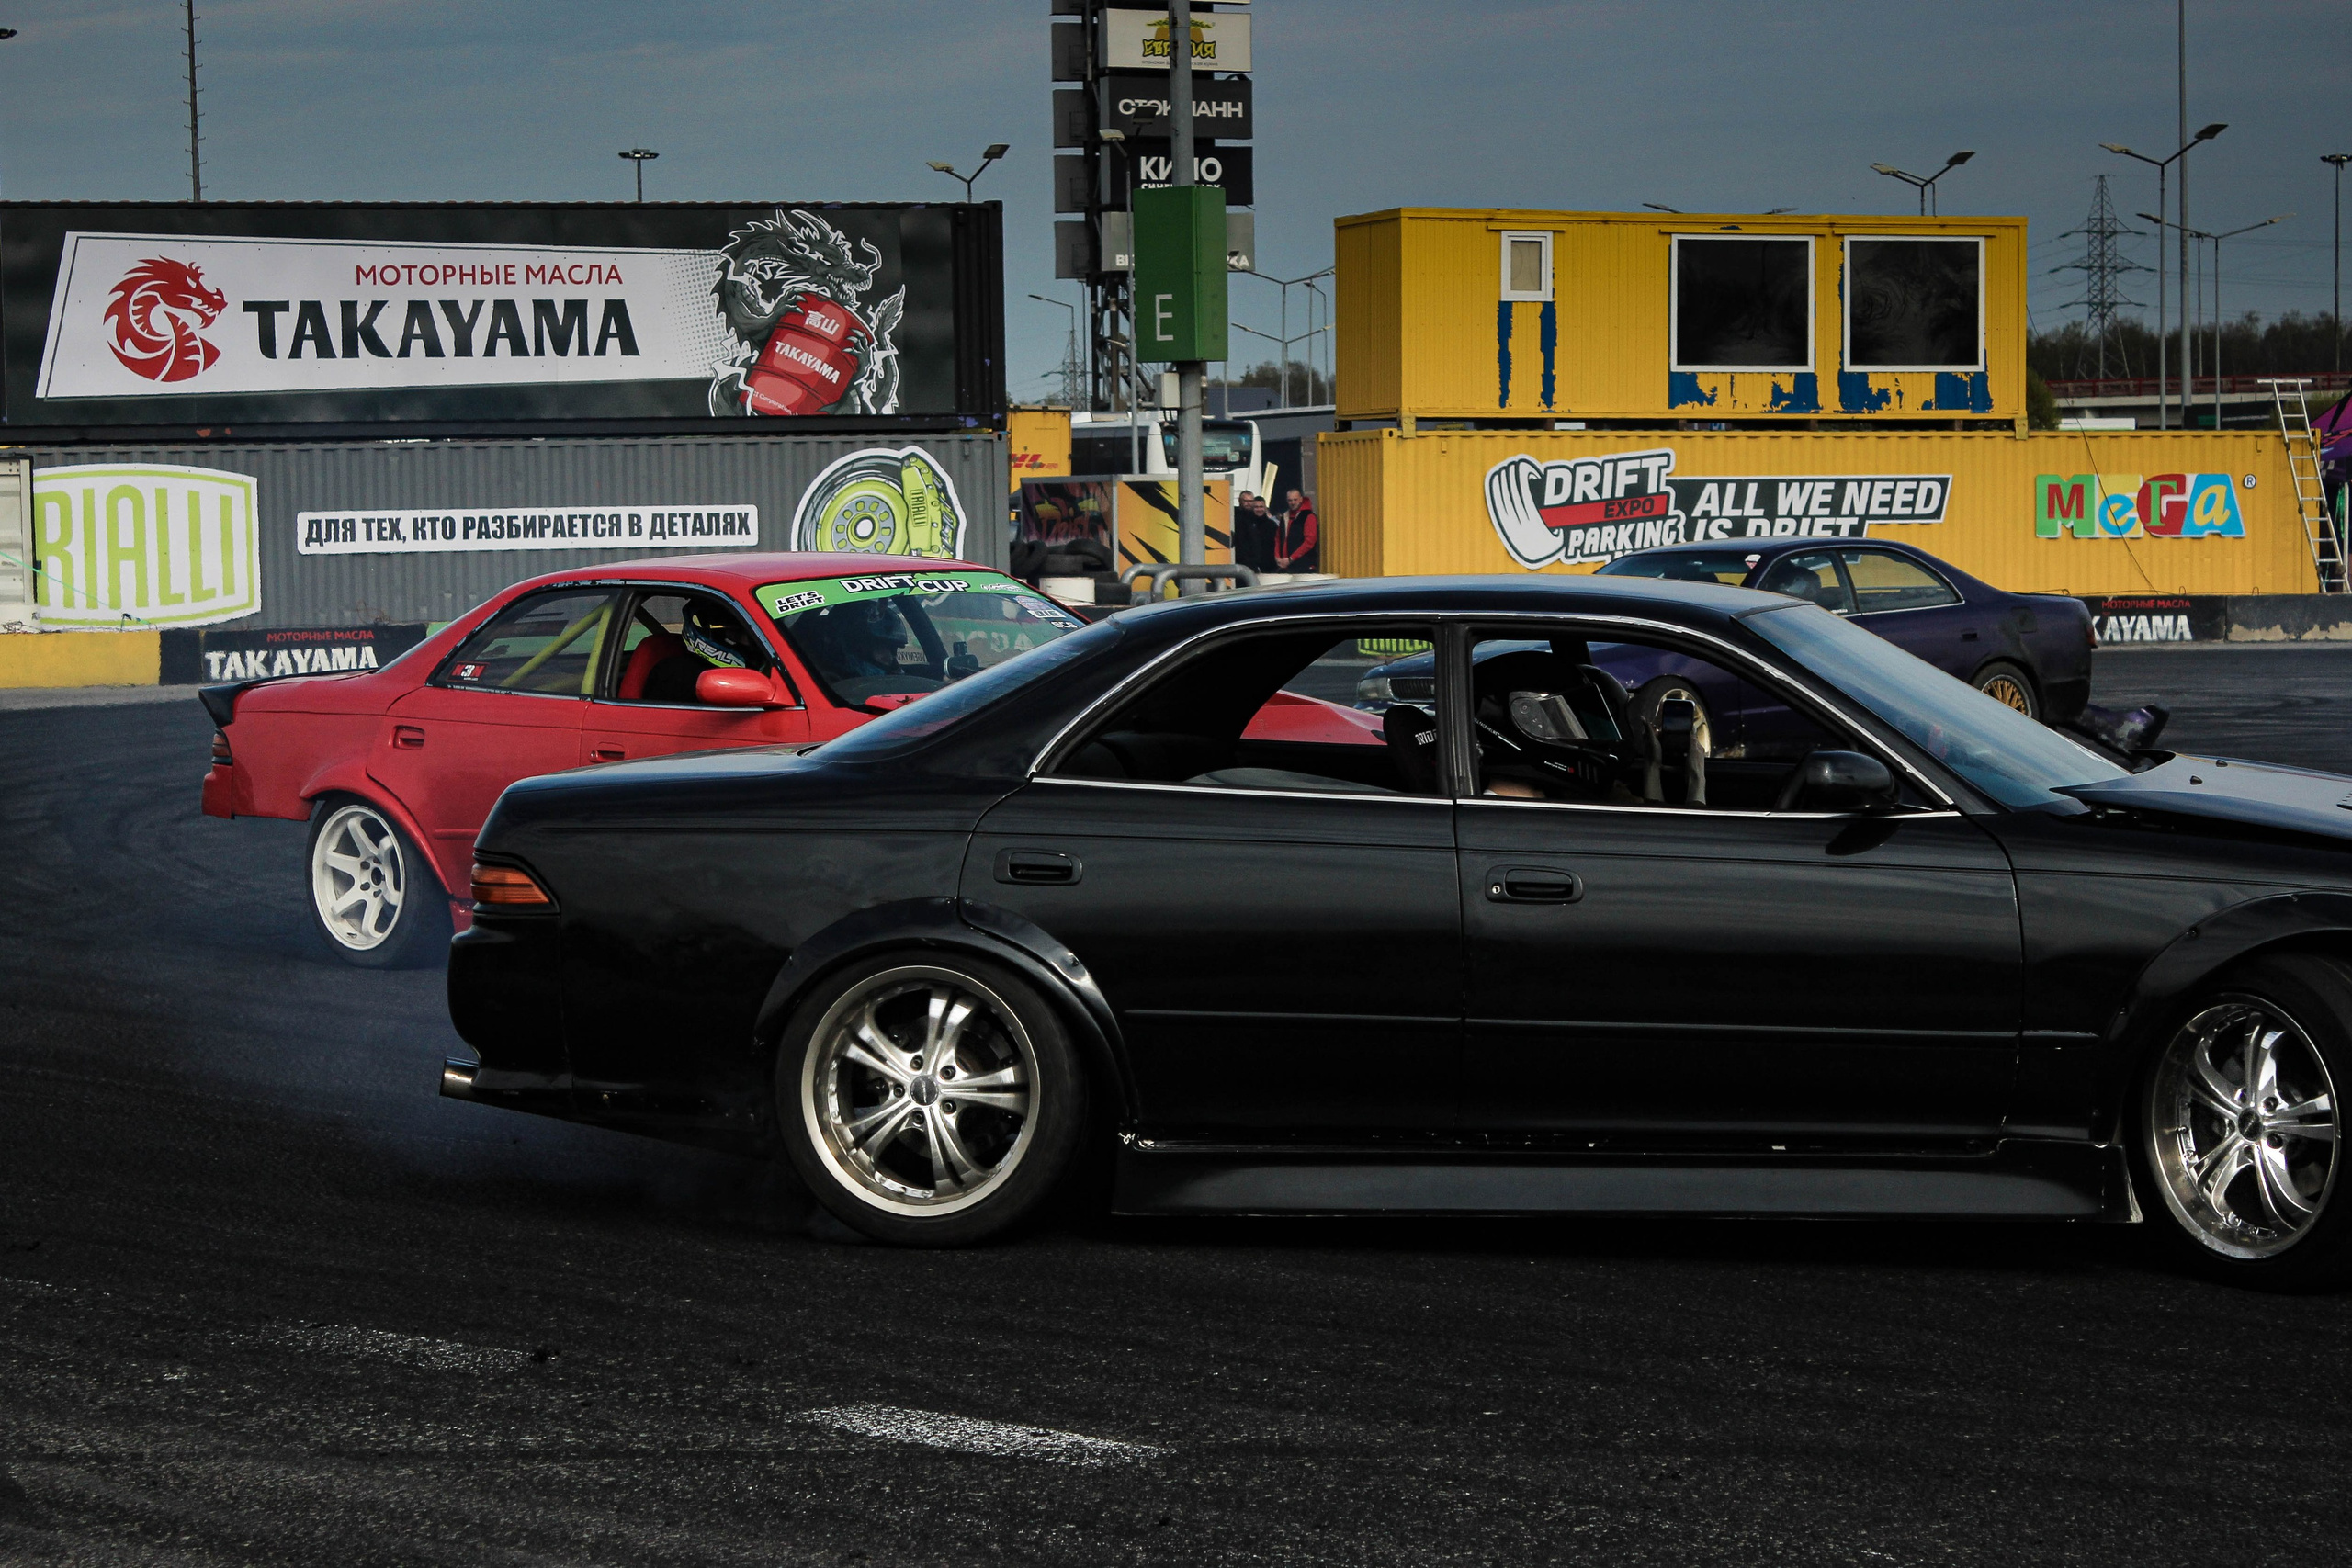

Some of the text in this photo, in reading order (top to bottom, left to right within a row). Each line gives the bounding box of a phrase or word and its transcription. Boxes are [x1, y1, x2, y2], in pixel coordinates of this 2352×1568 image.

[1143, 39, 1216, 59] ЕВРИЯ
[1140, 156, 1222, 182] КИО
[356, 264, 623, 286] МОТОРНЫЕ МАСЛА
[243, 299, 640, 359] TAKAYAMA
[804, 310, 840, 335] 高山
[1155, 293, 1174, 341] E
[775, 341, 841, 384] TAKAYAMA
[1544, 457, 1669, 506] DRIFT
[1603, 498, 1656, 518] EXPO
[1690, 480, 1943, 517] ALL WE NEED
[305, 512, 752, 547] ДЛЯ ТЕХ, КТО РАЗБИРАЕТСЯ В ДЕТАЛЯХ
[1568, 518, 1680, 553] PARKING
[34, 484, 236, 610] RIALLI
[840, 575, 914, 593] DRIFT
[918, 580, 969, 592] CUP
[777, 592, 818, 606] LET'S
[779, 597, 823, 614] DRIFT
[2102, 599, 2191, 609] МОТОРНЫЕ МАСЛА
[266, 630, 374, 642] МОТОРНЫЕ МАСЛА
[2092, 615, 2193, 641] KAYAMA
[204, 646, 379, 682] TAKAYAMA
